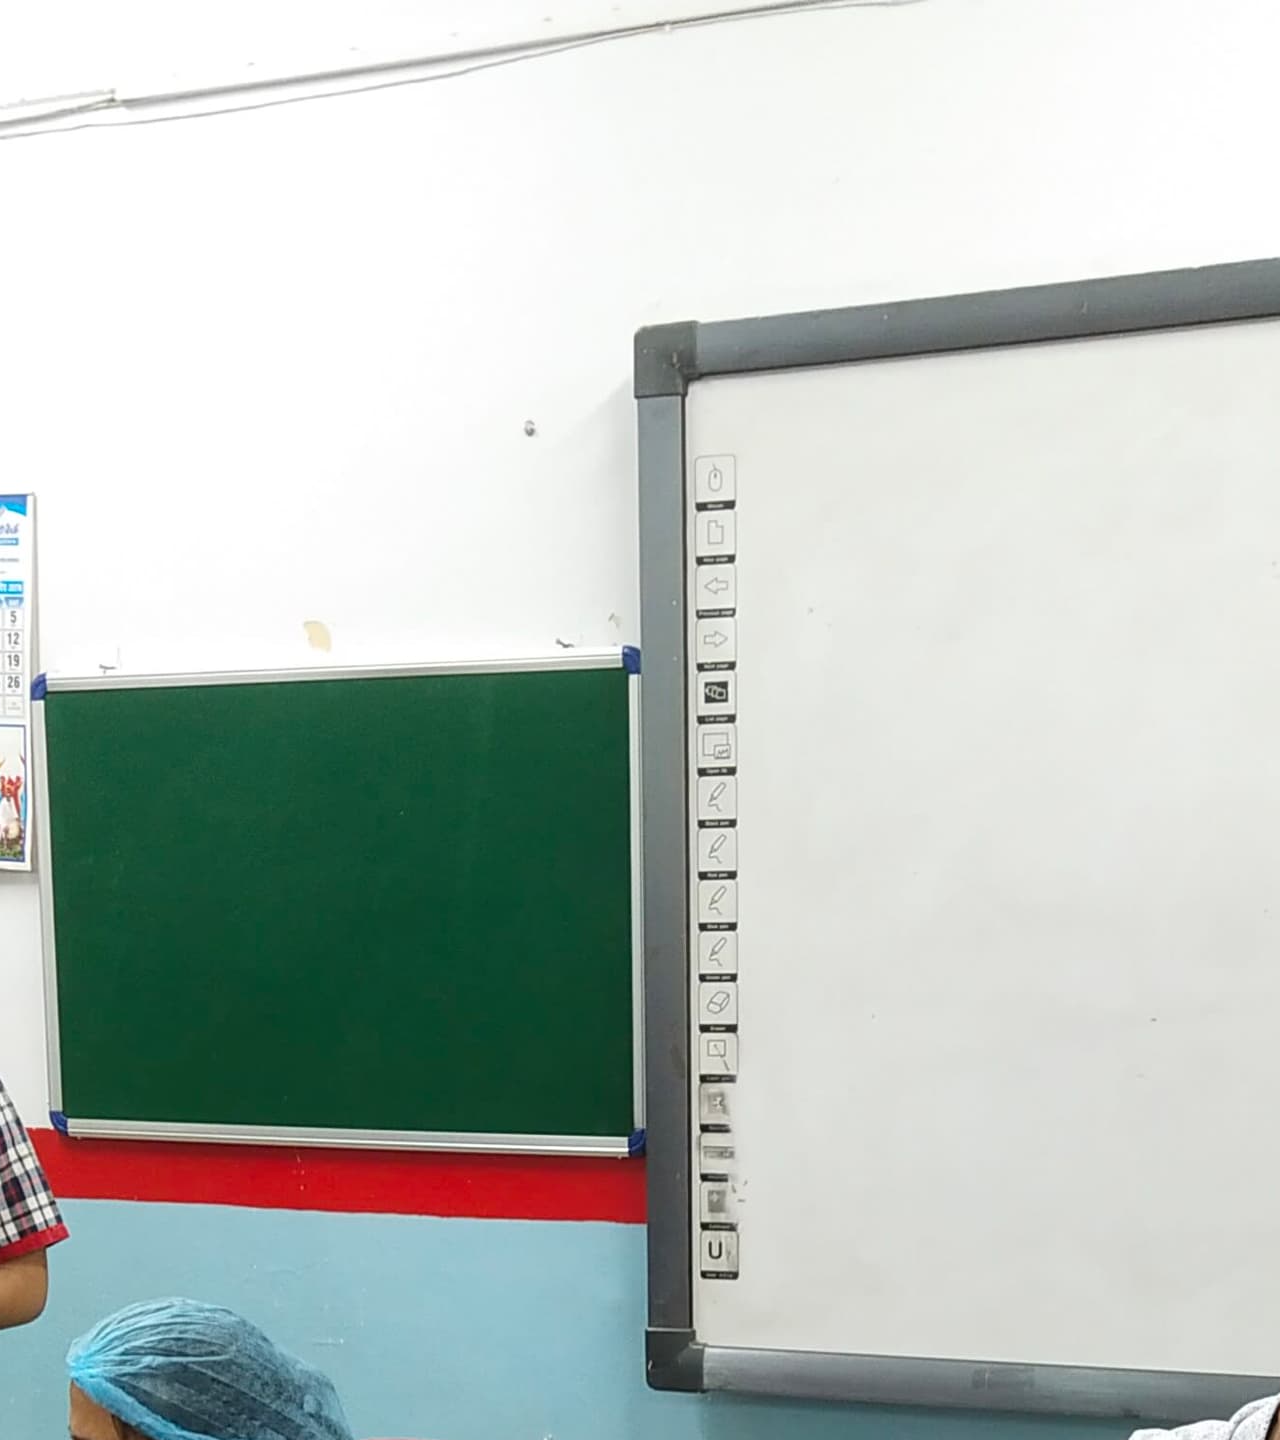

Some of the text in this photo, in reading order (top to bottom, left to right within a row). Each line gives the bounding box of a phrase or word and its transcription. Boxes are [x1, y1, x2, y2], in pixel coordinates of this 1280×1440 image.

[10, 610, 17, 623] 5
[7, 632, 20, 645] 12
[7, 654, 20, 667] 19
[7, 676, 20, 689] 26
